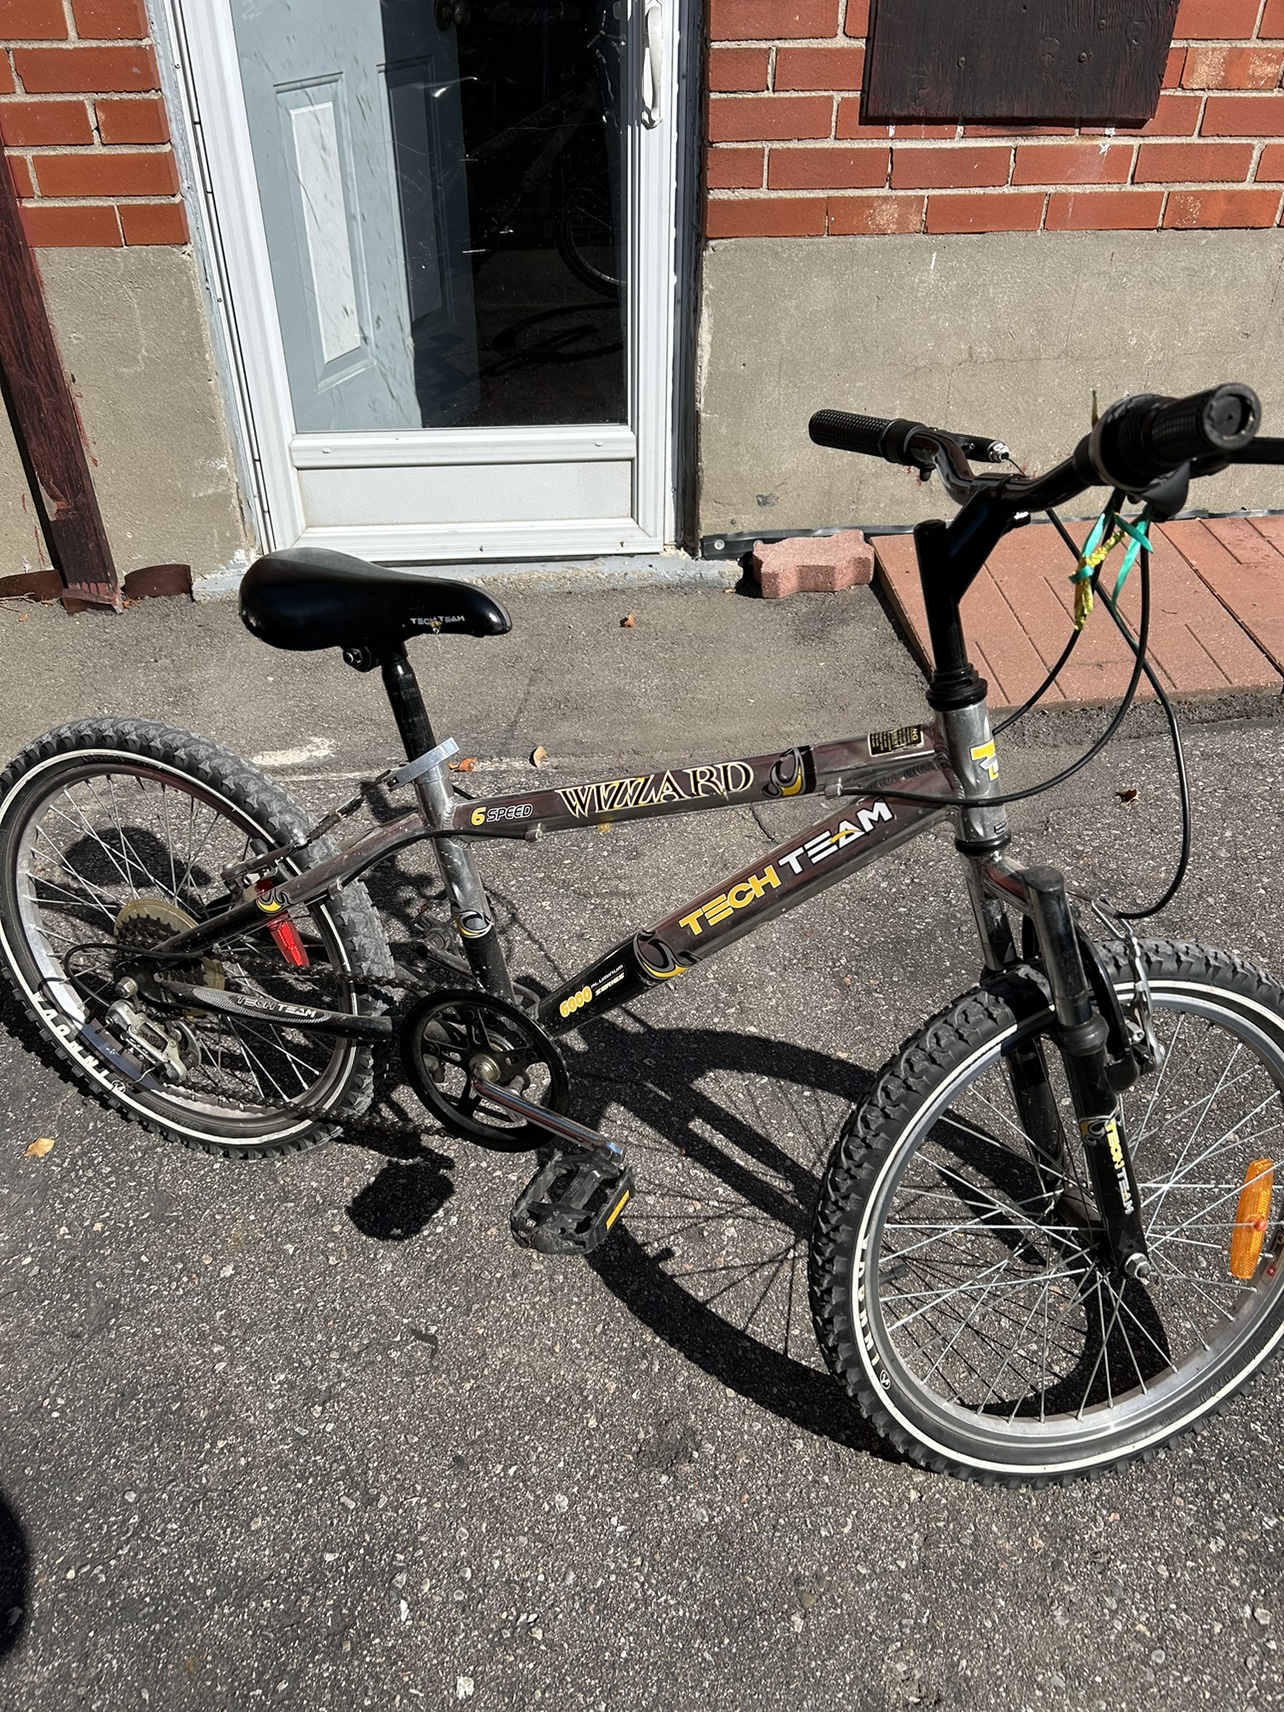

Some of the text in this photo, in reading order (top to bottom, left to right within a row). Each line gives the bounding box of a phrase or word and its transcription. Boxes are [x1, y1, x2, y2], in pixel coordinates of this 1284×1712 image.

[437, 615, 465, 624] TEAM
[554, 761, 755, 818] WIZZARD
[470, 803, 533, 826] 6 SPEED
[678, 797, 894, 937] TECH TEAM
[236, 995, 317, 1018] TECH TEAM
[560, 972, 625, 1018] 6000 SERIES
[1104, 1117, 1135, 1215] TECH TEAM
